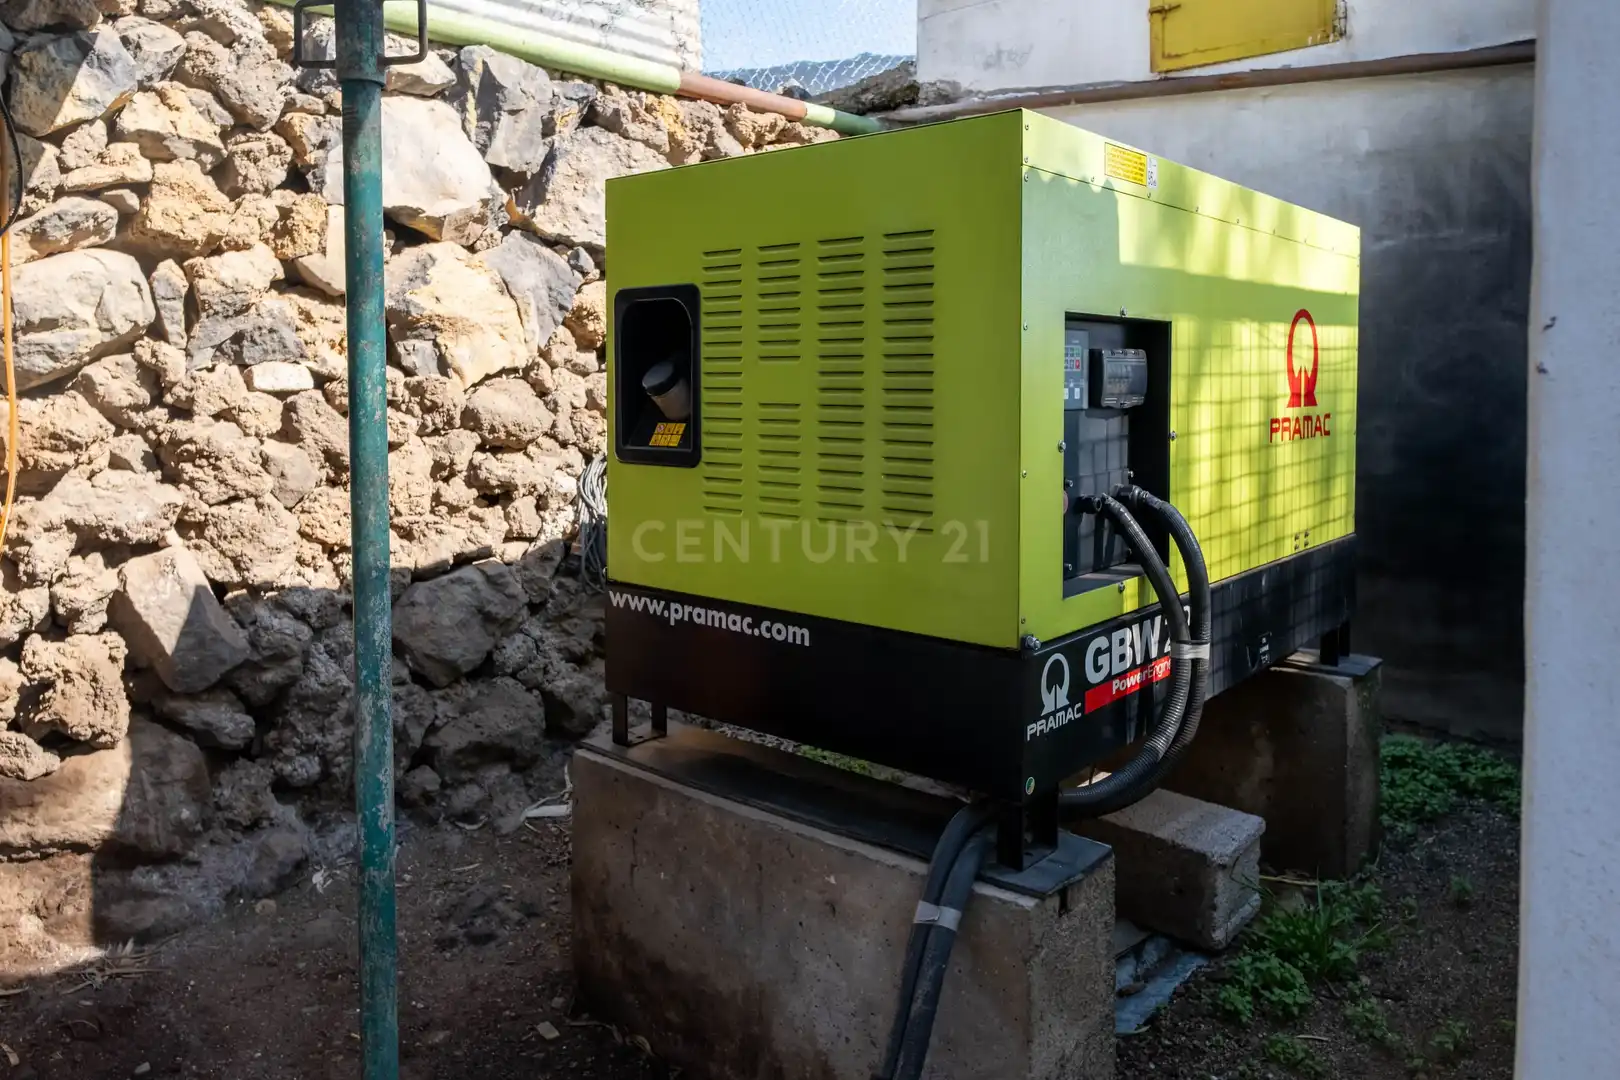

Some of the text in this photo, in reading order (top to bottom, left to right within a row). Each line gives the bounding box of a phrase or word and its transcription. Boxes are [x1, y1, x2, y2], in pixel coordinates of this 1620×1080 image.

[1269, 412, 1331, 443] PRAMAC
[608, 590, 811, 647] www.pramac.com
[1026, 702, 1082, 741] PRAMAC
